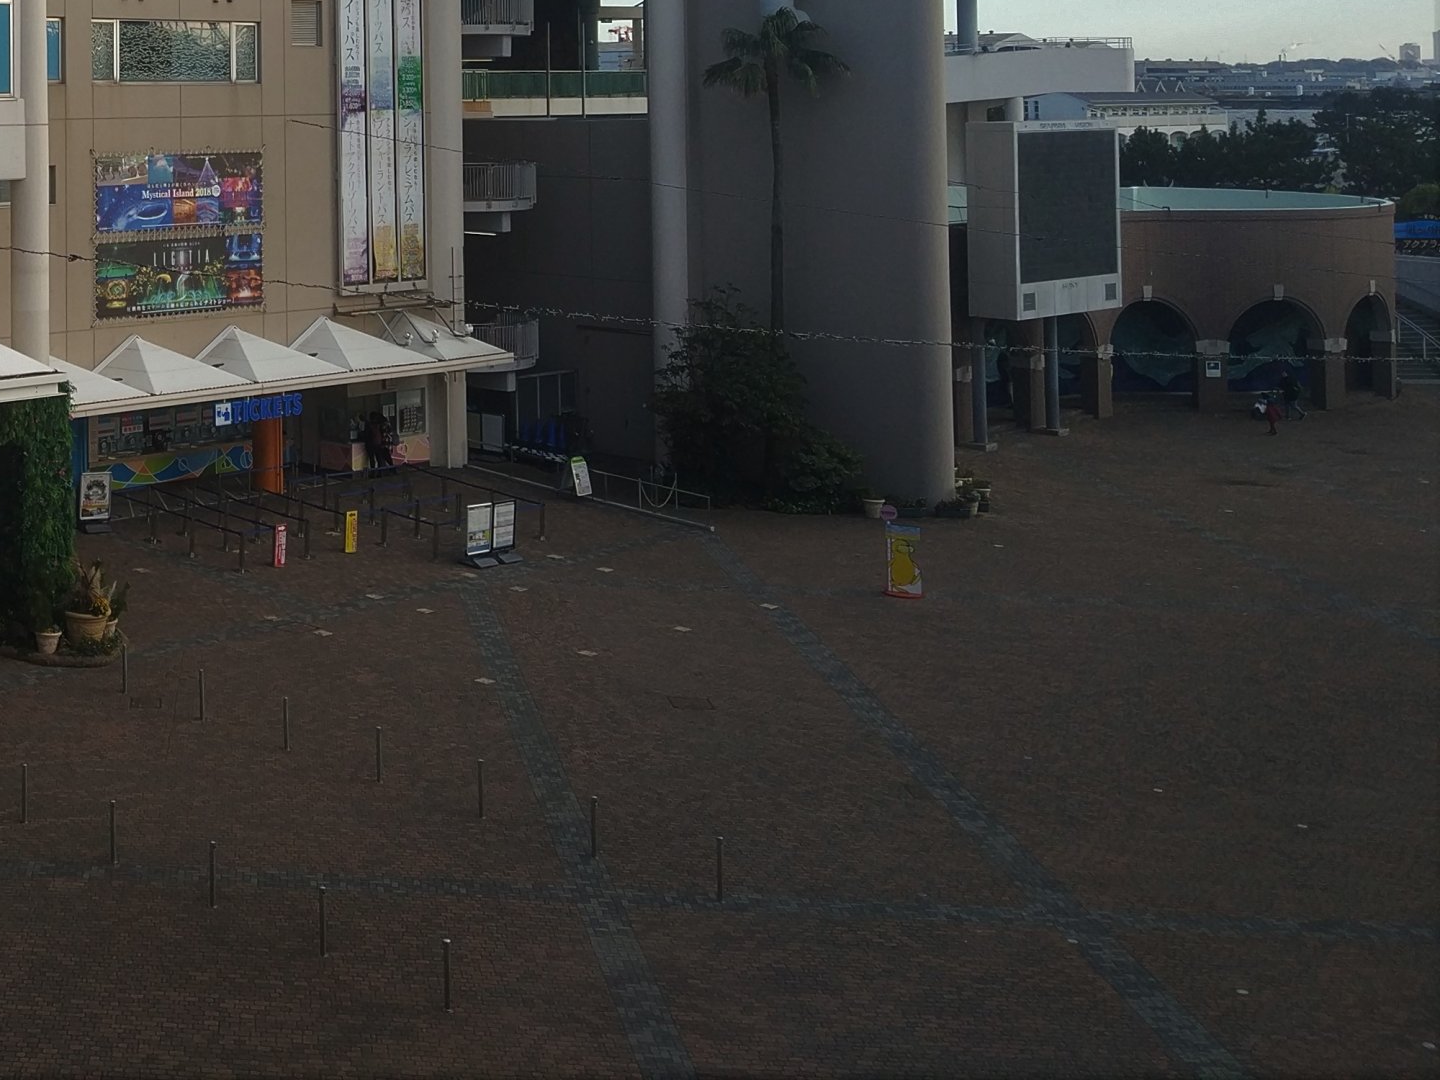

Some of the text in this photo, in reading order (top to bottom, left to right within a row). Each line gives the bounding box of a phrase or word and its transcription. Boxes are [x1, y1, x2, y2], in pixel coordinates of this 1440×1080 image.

[141, 187, 212, 200] Mystical Island 2018
[231, 391, 304, 424] TICKETS
